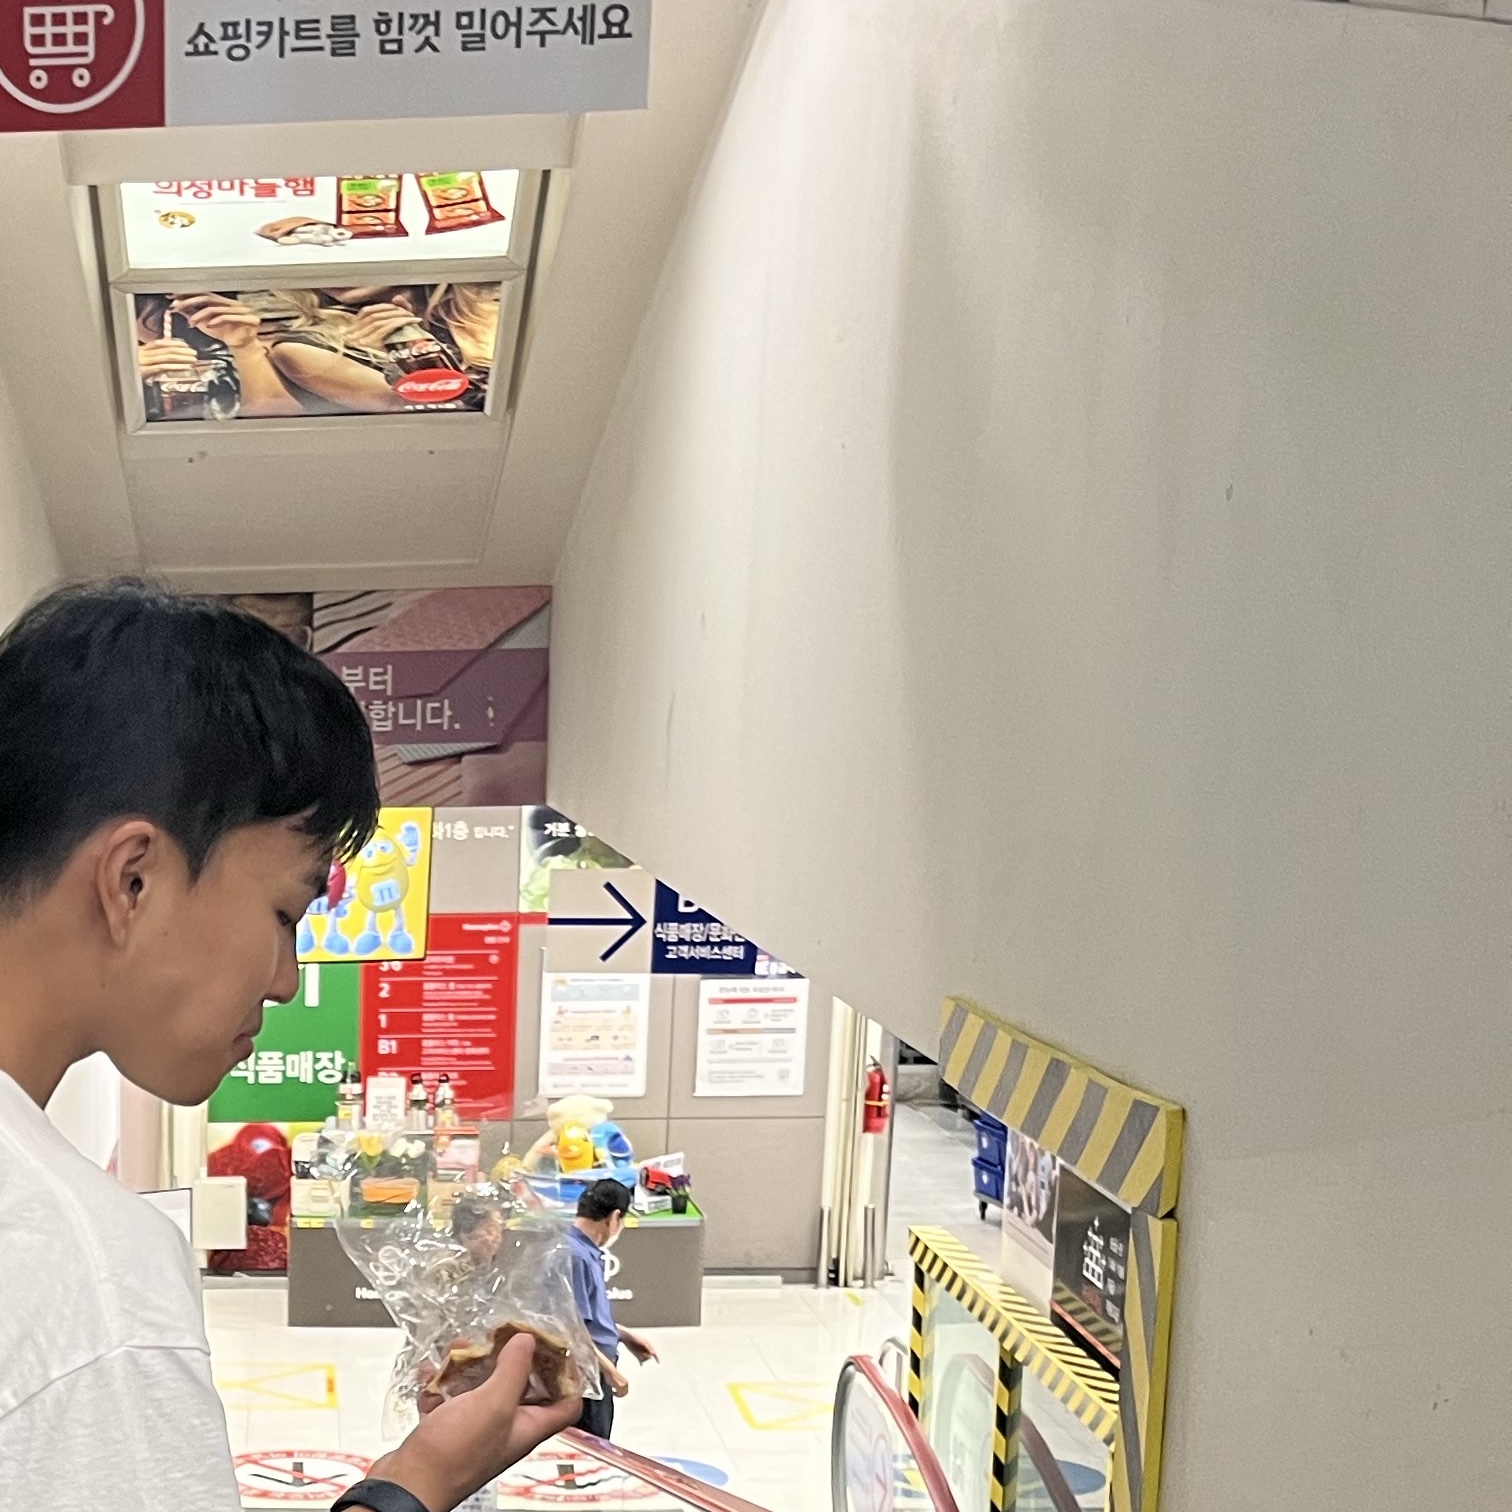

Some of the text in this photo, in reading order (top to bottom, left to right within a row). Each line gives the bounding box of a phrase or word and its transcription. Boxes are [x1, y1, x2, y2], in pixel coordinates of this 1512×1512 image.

[184, 3, 633, 62] 쇼핑카트를 힘껏 밀어주세요
[665, 944, 744, 960] 고객서비스센터
[378, 983, 391, 999] 2
[378, 1013, 388, 1029] 1
[377, 1039, 398, 1055] B1
